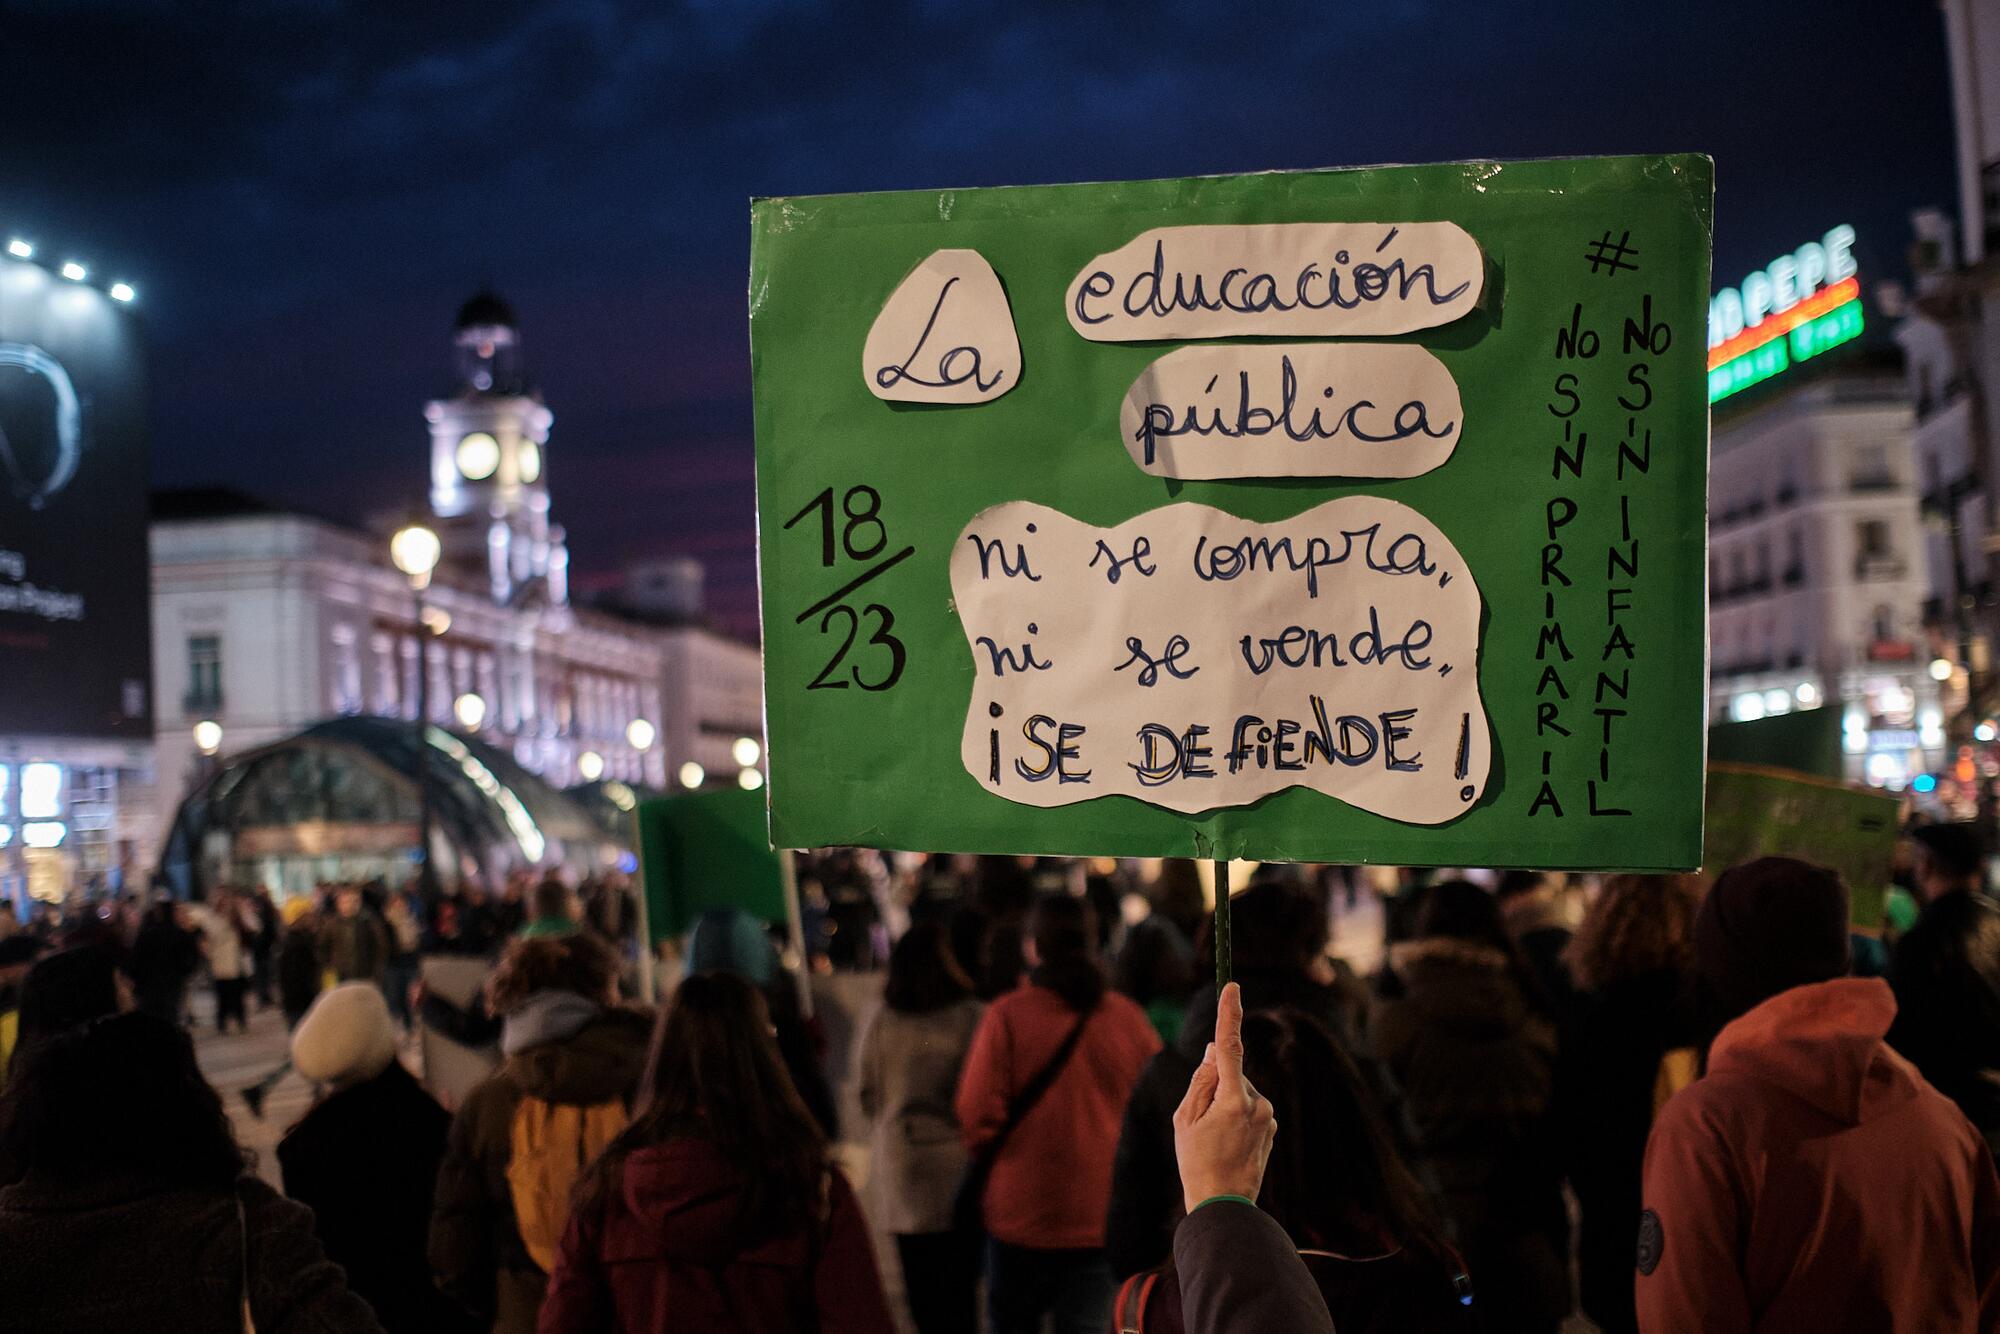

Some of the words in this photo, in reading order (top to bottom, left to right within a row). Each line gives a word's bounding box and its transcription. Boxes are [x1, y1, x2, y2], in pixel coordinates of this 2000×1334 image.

[1584, 230, 1640, 277] #
[877, 277, 1004, 390] La
[1075, 228, 1471, 325] educación
[1136, 355, 1455, 465] pública
[783, 484, 888, 568] 18
[967, 522, 1042, 582] ni
[1089, 535, 1158, 585] se
[806, 603, 907, 692] 23
[975, 622, 1053, 677] ni
[1113, 634, 1201, 688] se
